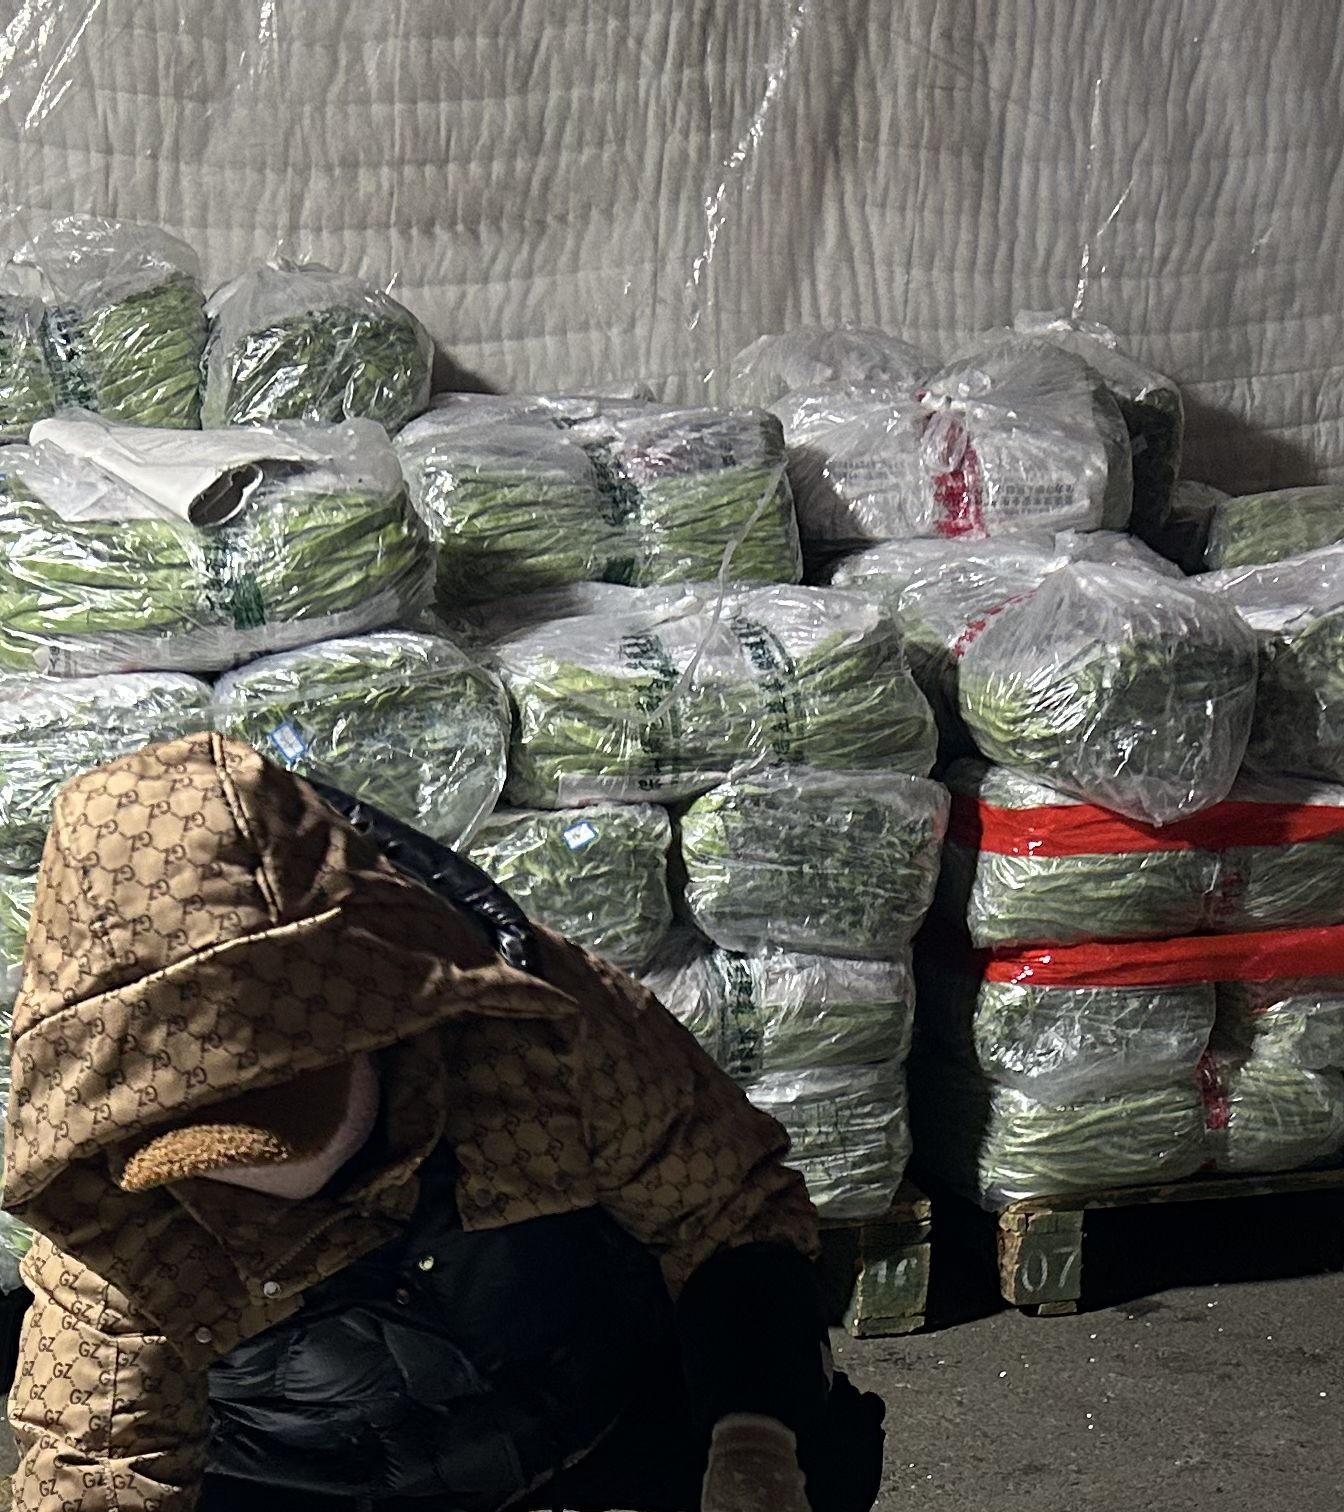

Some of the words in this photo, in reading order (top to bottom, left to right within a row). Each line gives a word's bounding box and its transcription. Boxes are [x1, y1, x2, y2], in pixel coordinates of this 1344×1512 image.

[1021, 1247, 1079, 1292] 07
[59, 1271, 78, 1289] GZ
[72, 1301, 94, 1319] GZ
[62, 1315, 80, 1331] GZ
[38, 1336, 55, 1352] GZ
[79, 1341, 101, 1359] GZ
[118, 1352, 139, 1367] GZ
[22, 1361, 35, 1377] GZ
[53, 1363, 73, 1380] GZ
[29, 1384, 46, 1401] GZ
[70, 1389, 93, 1406] GZ
[44, 1409, 63, 1426] GZ
[40, 1435, 58, 1449] GZ
[39, 1479, 58, 1496] GZ
[83, 1472, 106, 1488] GZ
[113, 1475, 137, 1490] GZ
